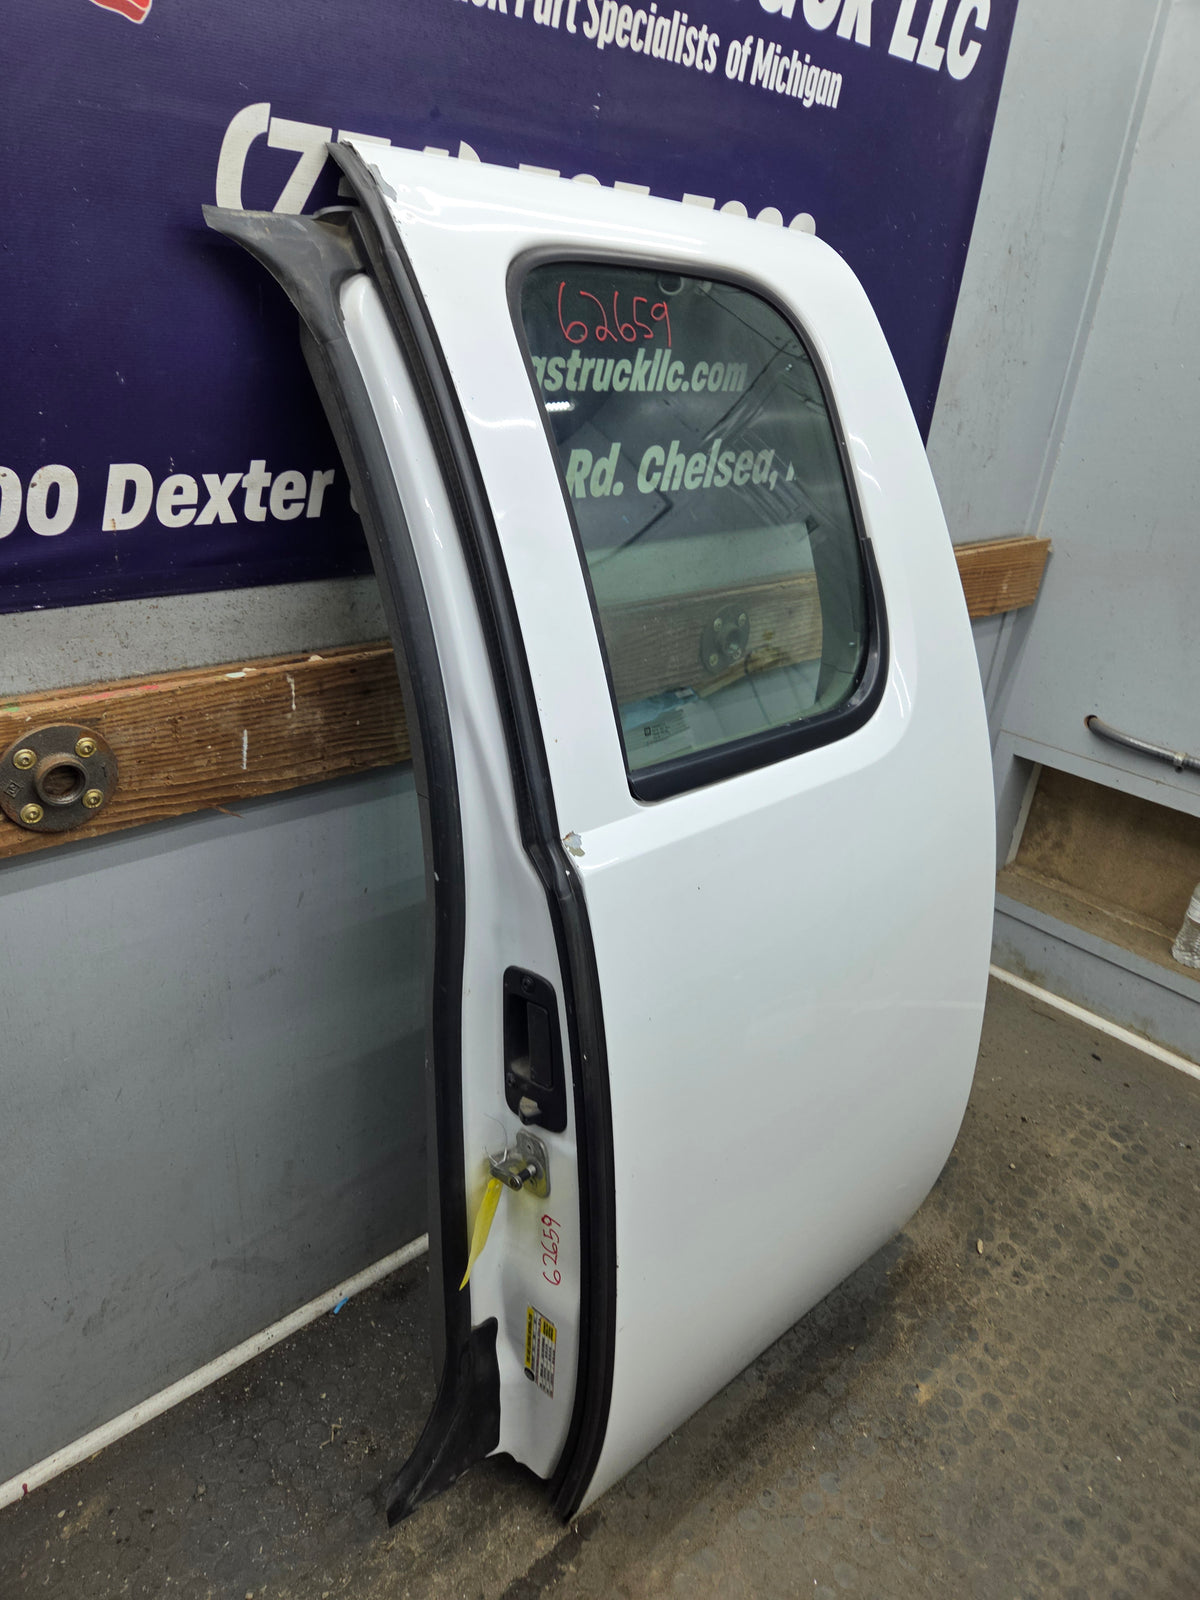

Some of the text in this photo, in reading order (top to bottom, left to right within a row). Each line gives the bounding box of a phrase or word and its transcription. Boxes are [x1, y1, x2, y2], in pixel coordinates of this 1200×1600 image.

[583, 0, 720, 73] Specialists
[725, 35, 754, 82] of
[750, 38, 843, 109] Michigan
[888, 0, 990, 80] LLC
[558, 281, 672, 347] 62659
[101, 460, 335, 531] Dexter
[565, 442, 624, 498] Rd.
[637, 438, 779, 494] Chelsea,
[541, 1214, 561, 1286] 62659
